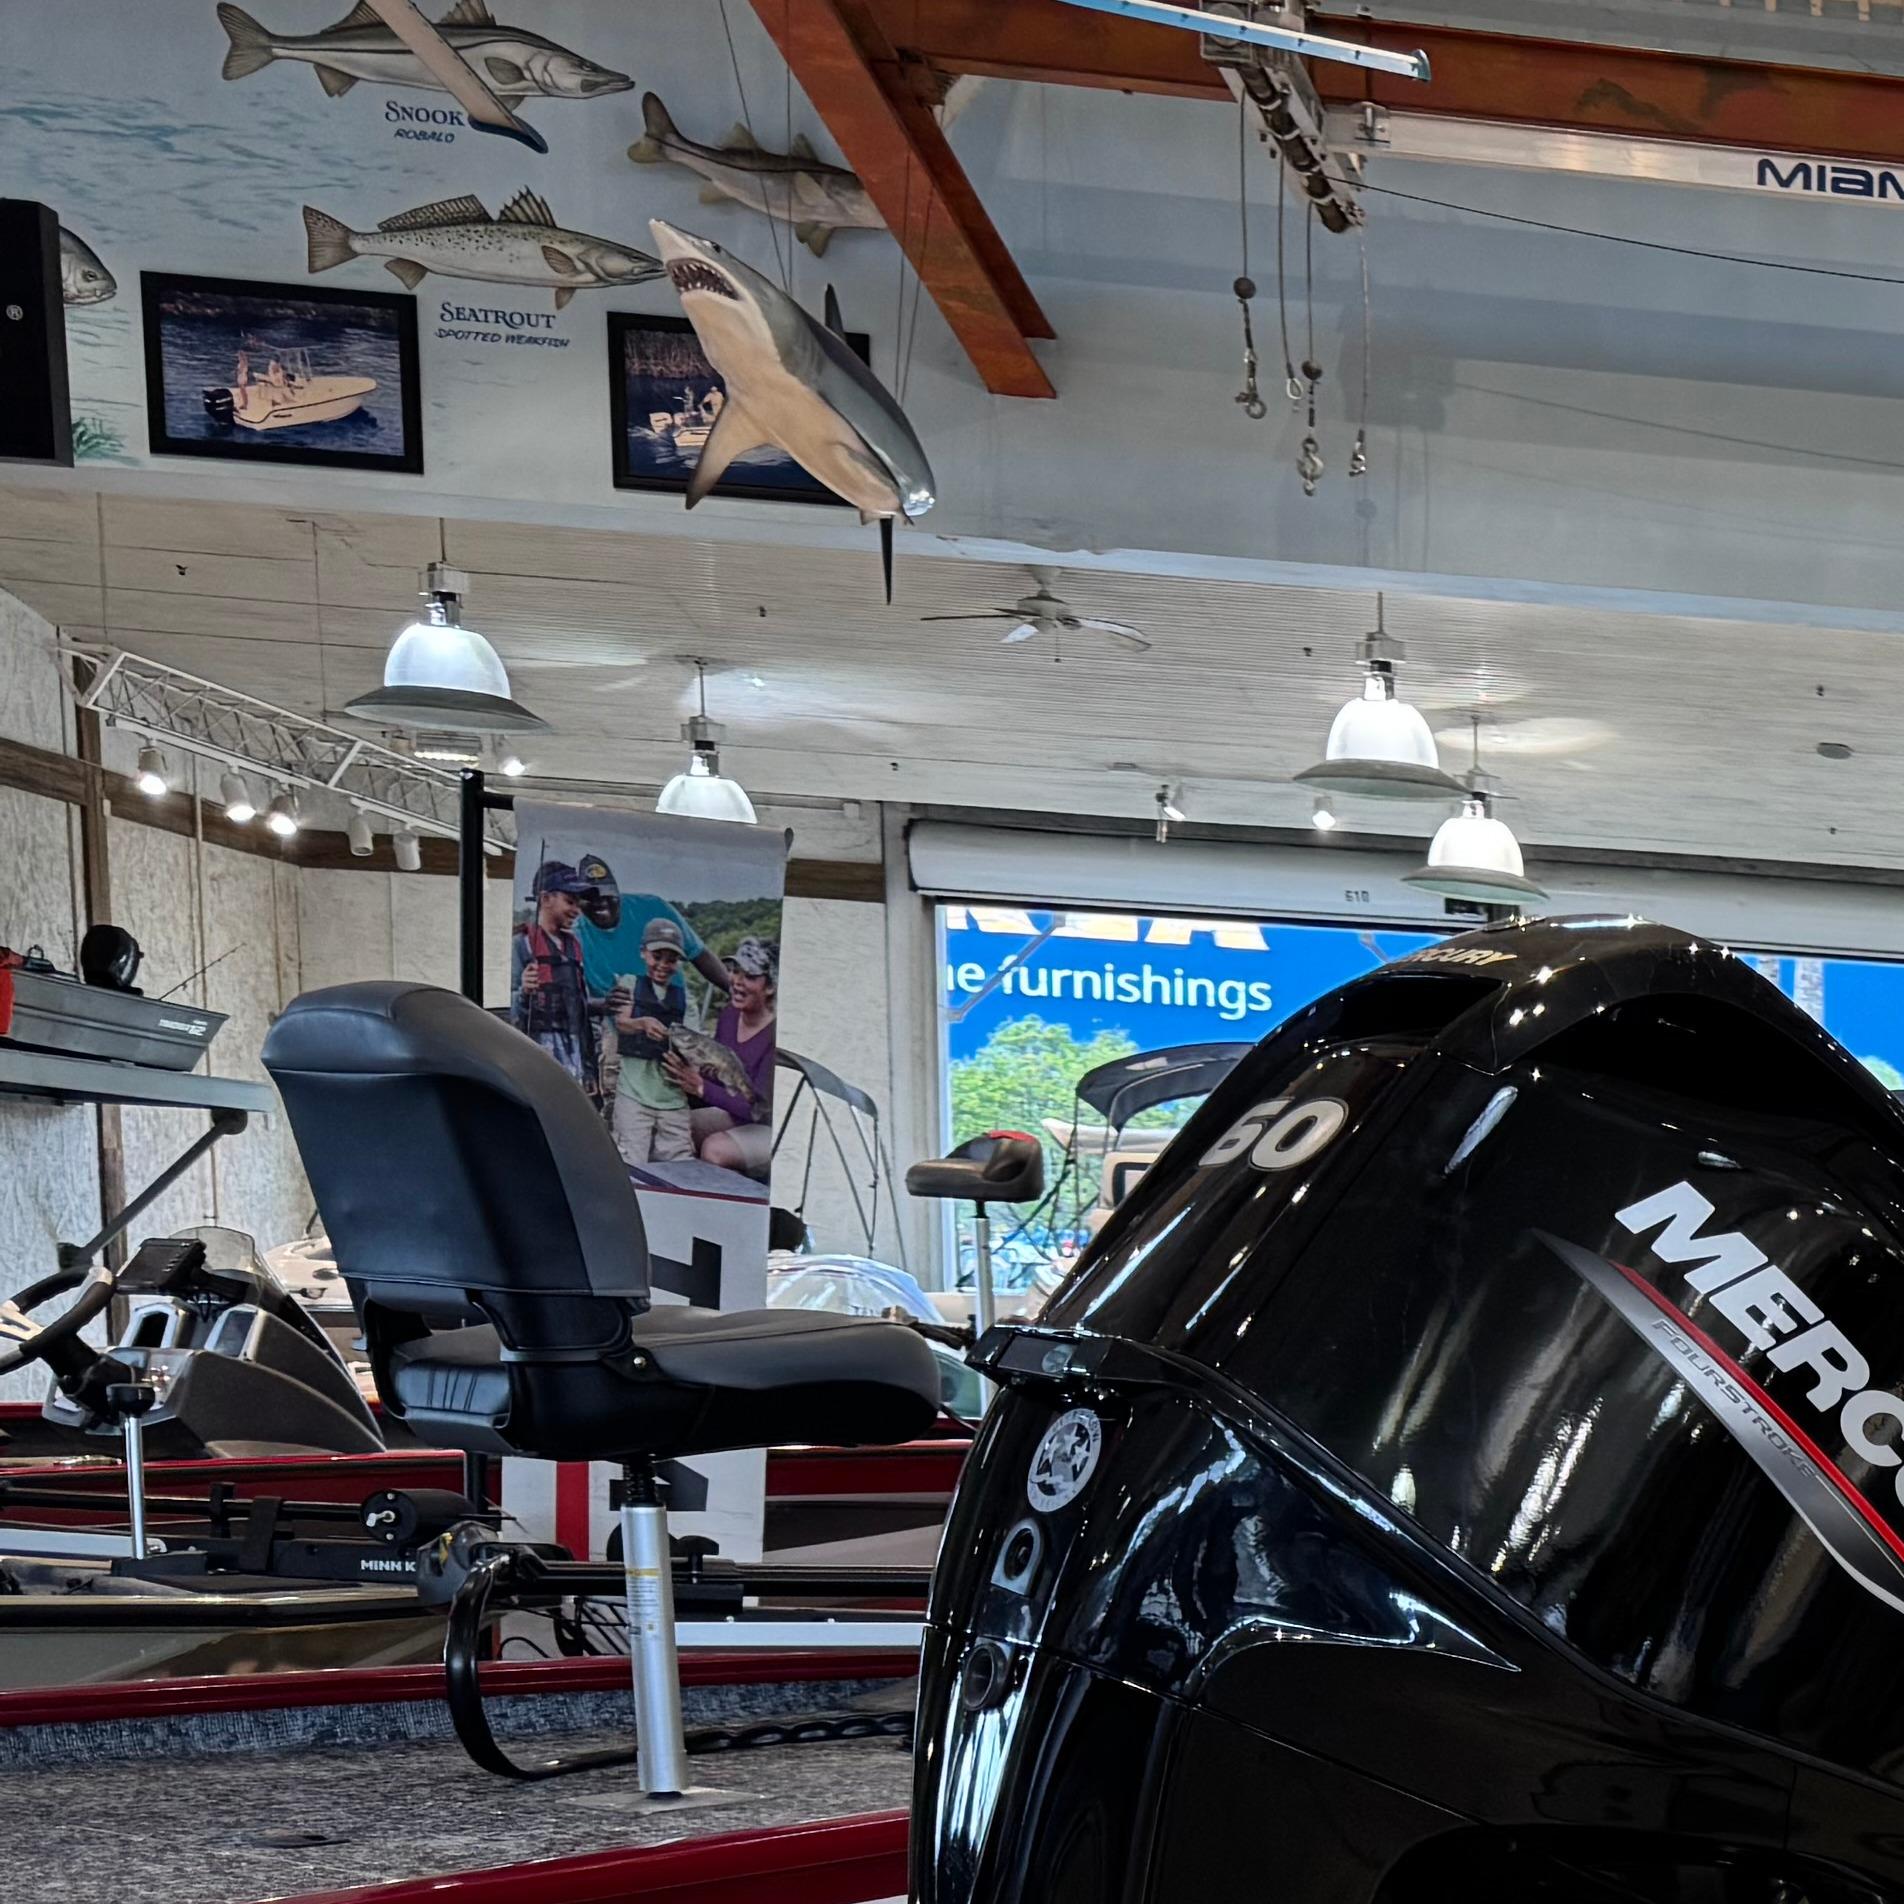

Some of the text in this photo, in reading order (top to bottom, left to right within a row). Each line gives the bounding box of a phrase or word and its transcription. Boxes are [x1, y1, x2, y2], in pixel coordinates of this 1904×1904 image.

[385, 100, 465, 126] SNOOK
[440, 301, 556, 329] SEATROUT
[998, 953, 1273, 1022] furnishings
[1198, 1096, 1350, 1172] 60
[360, 1559, 402, 1571] MINN
